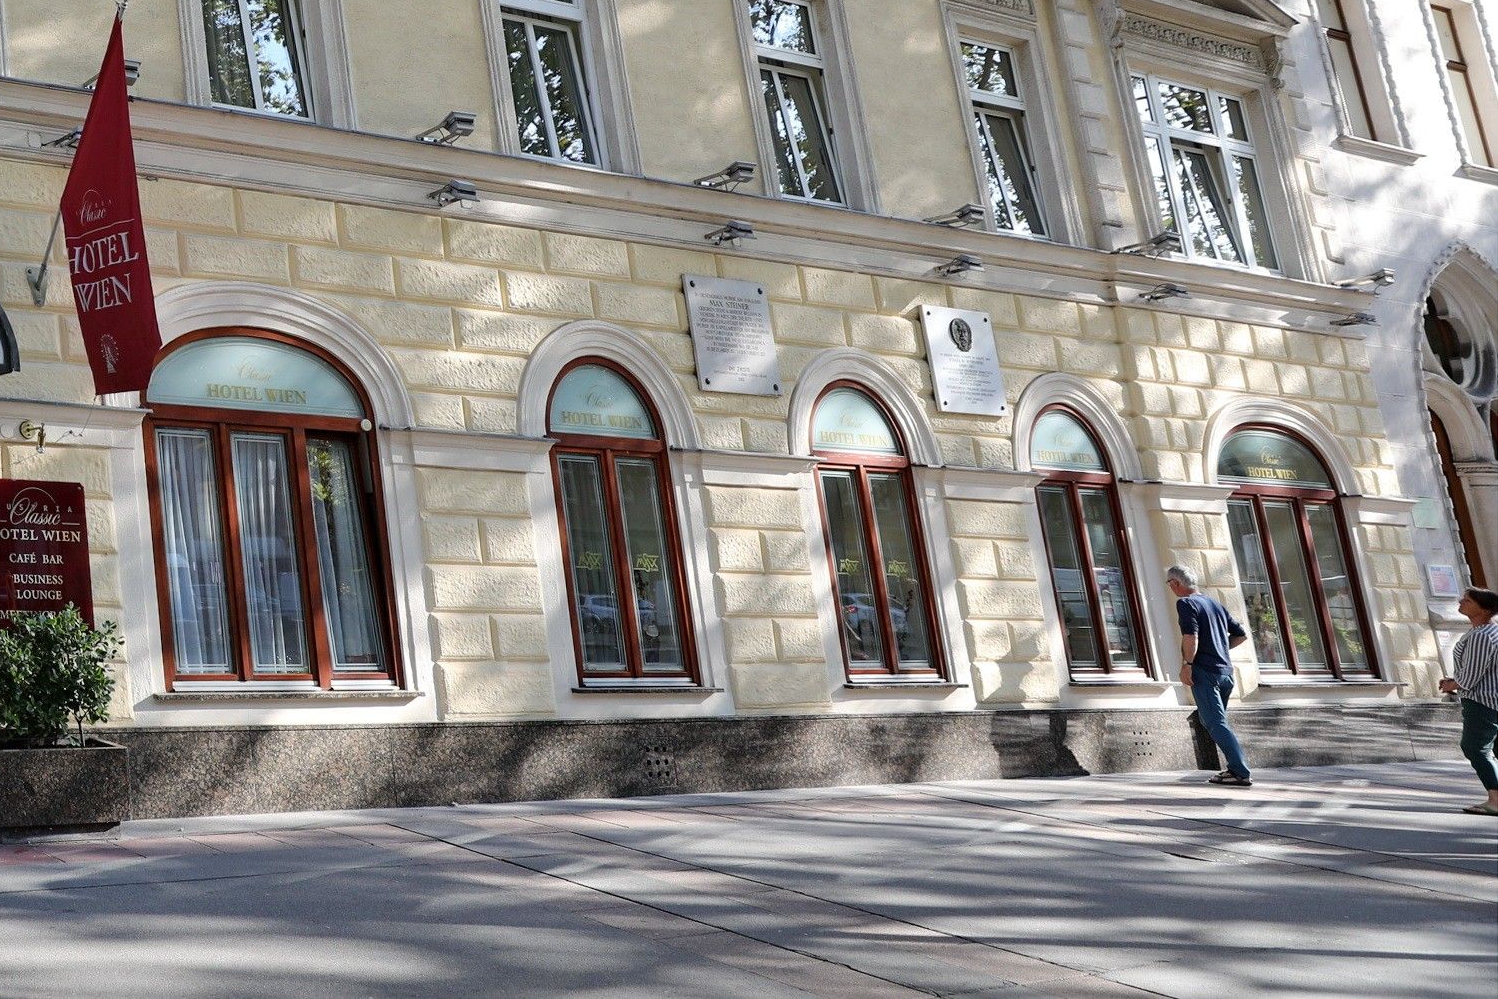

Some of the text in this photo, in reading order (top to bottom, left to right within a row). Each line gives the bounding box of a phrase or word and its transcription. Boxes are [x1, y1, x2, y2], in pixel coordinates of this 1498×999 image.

[66, 231, 140, 277] HOTEL
[75, 273, 133, 313] WIEN
[206, 383, 307, 404] HOTEL WIEN
[562, 411, 642, 429] HOTEL WIEN
[1246, 466, 1298, 480] HOTEL WIEN
[9, 498, 61, 525] Classic
[42, 529, 81, 543] WIEN
[9, 552, 64, 565] CAFÉ BAR
[13, 574, 64, 585] BUSINESS
[16, 589, 63, 600] LOUNGE
